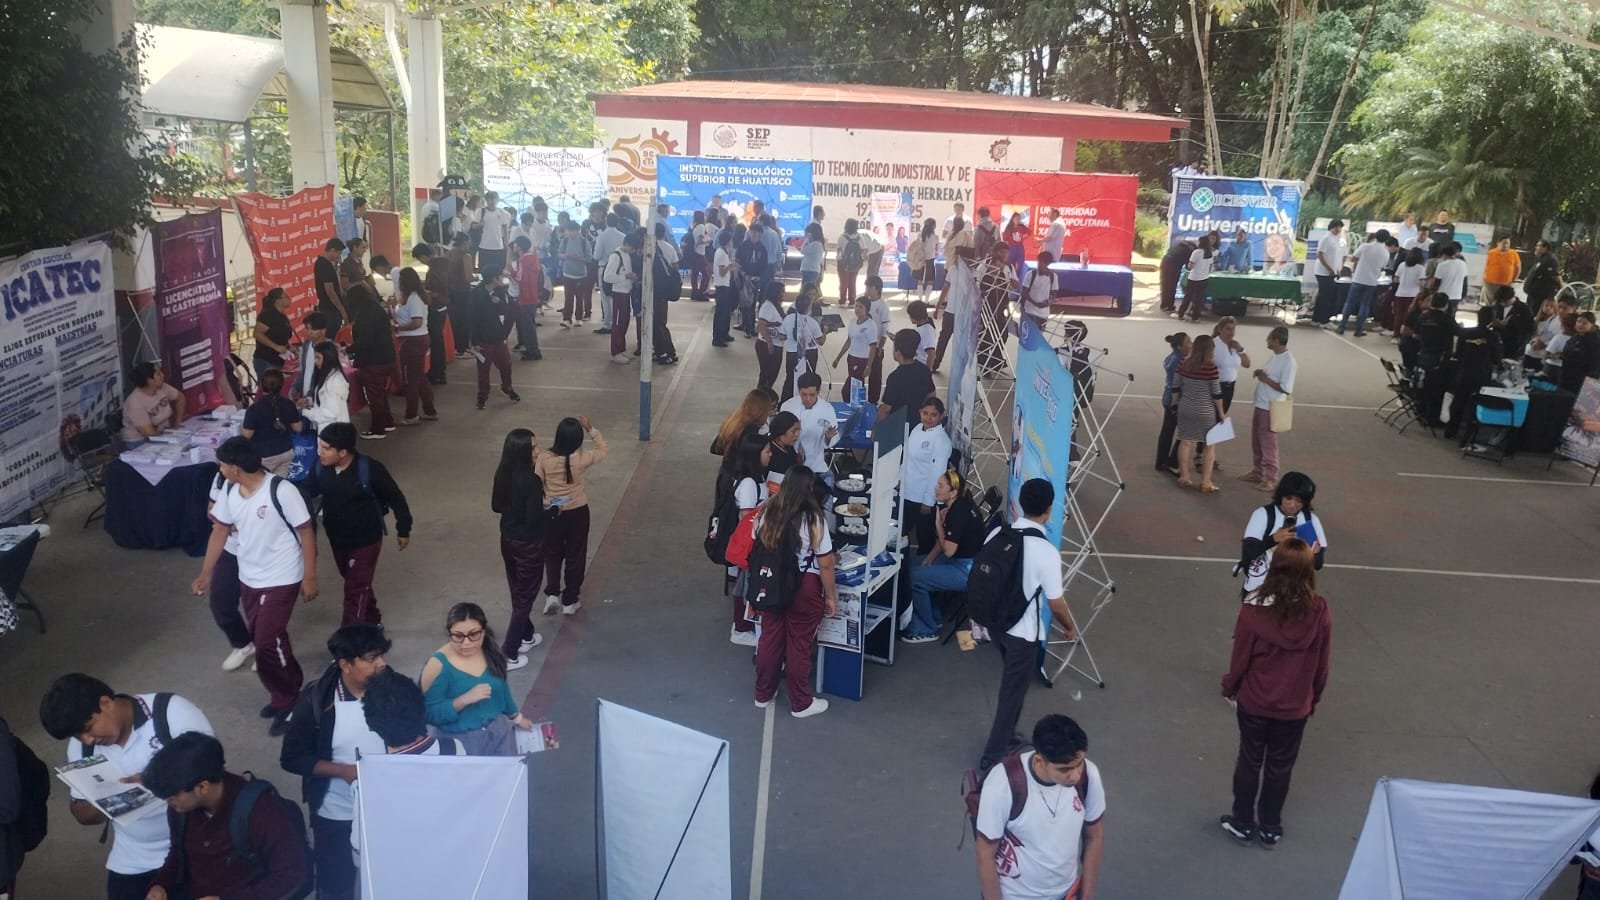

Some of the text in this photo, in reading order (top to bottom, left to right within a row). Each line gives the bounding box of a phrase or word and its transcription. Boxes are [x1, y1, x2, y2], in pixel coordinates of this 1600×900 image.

[746, 127, 770, 139] SEP
[521, 159, 592, 168] MESOAMERICANA
[527, 150, 583, 160] UNIVERSIDAD
[679, 164, 793, 177] INSTITUTO TECNOLÓGICO
[680, 174, 792, 186] SUPERIOR DE HUATUSCO
[828, 158, 889, 178] TECNOLÓGICO
[892, 163, 944, 181] INDUSTRIAL
[946, 165, 955, 182] Y
[958, 167, 971, 182] DE
[918, 187, 963, 201] HERRERA
[1178, 213, 1294, 234] Universidad
[1, 258, 101, 321] ICATEC
[165, 281, 217, 305] LICENCIATURA
[172, 289, 222, 312] GASTRONOMÍA
[24, 327, 56, 346] ESTUDIAR
[57, 321, 71, 333] CON
[55, 321, 97, 348] MAESTRÍAS
